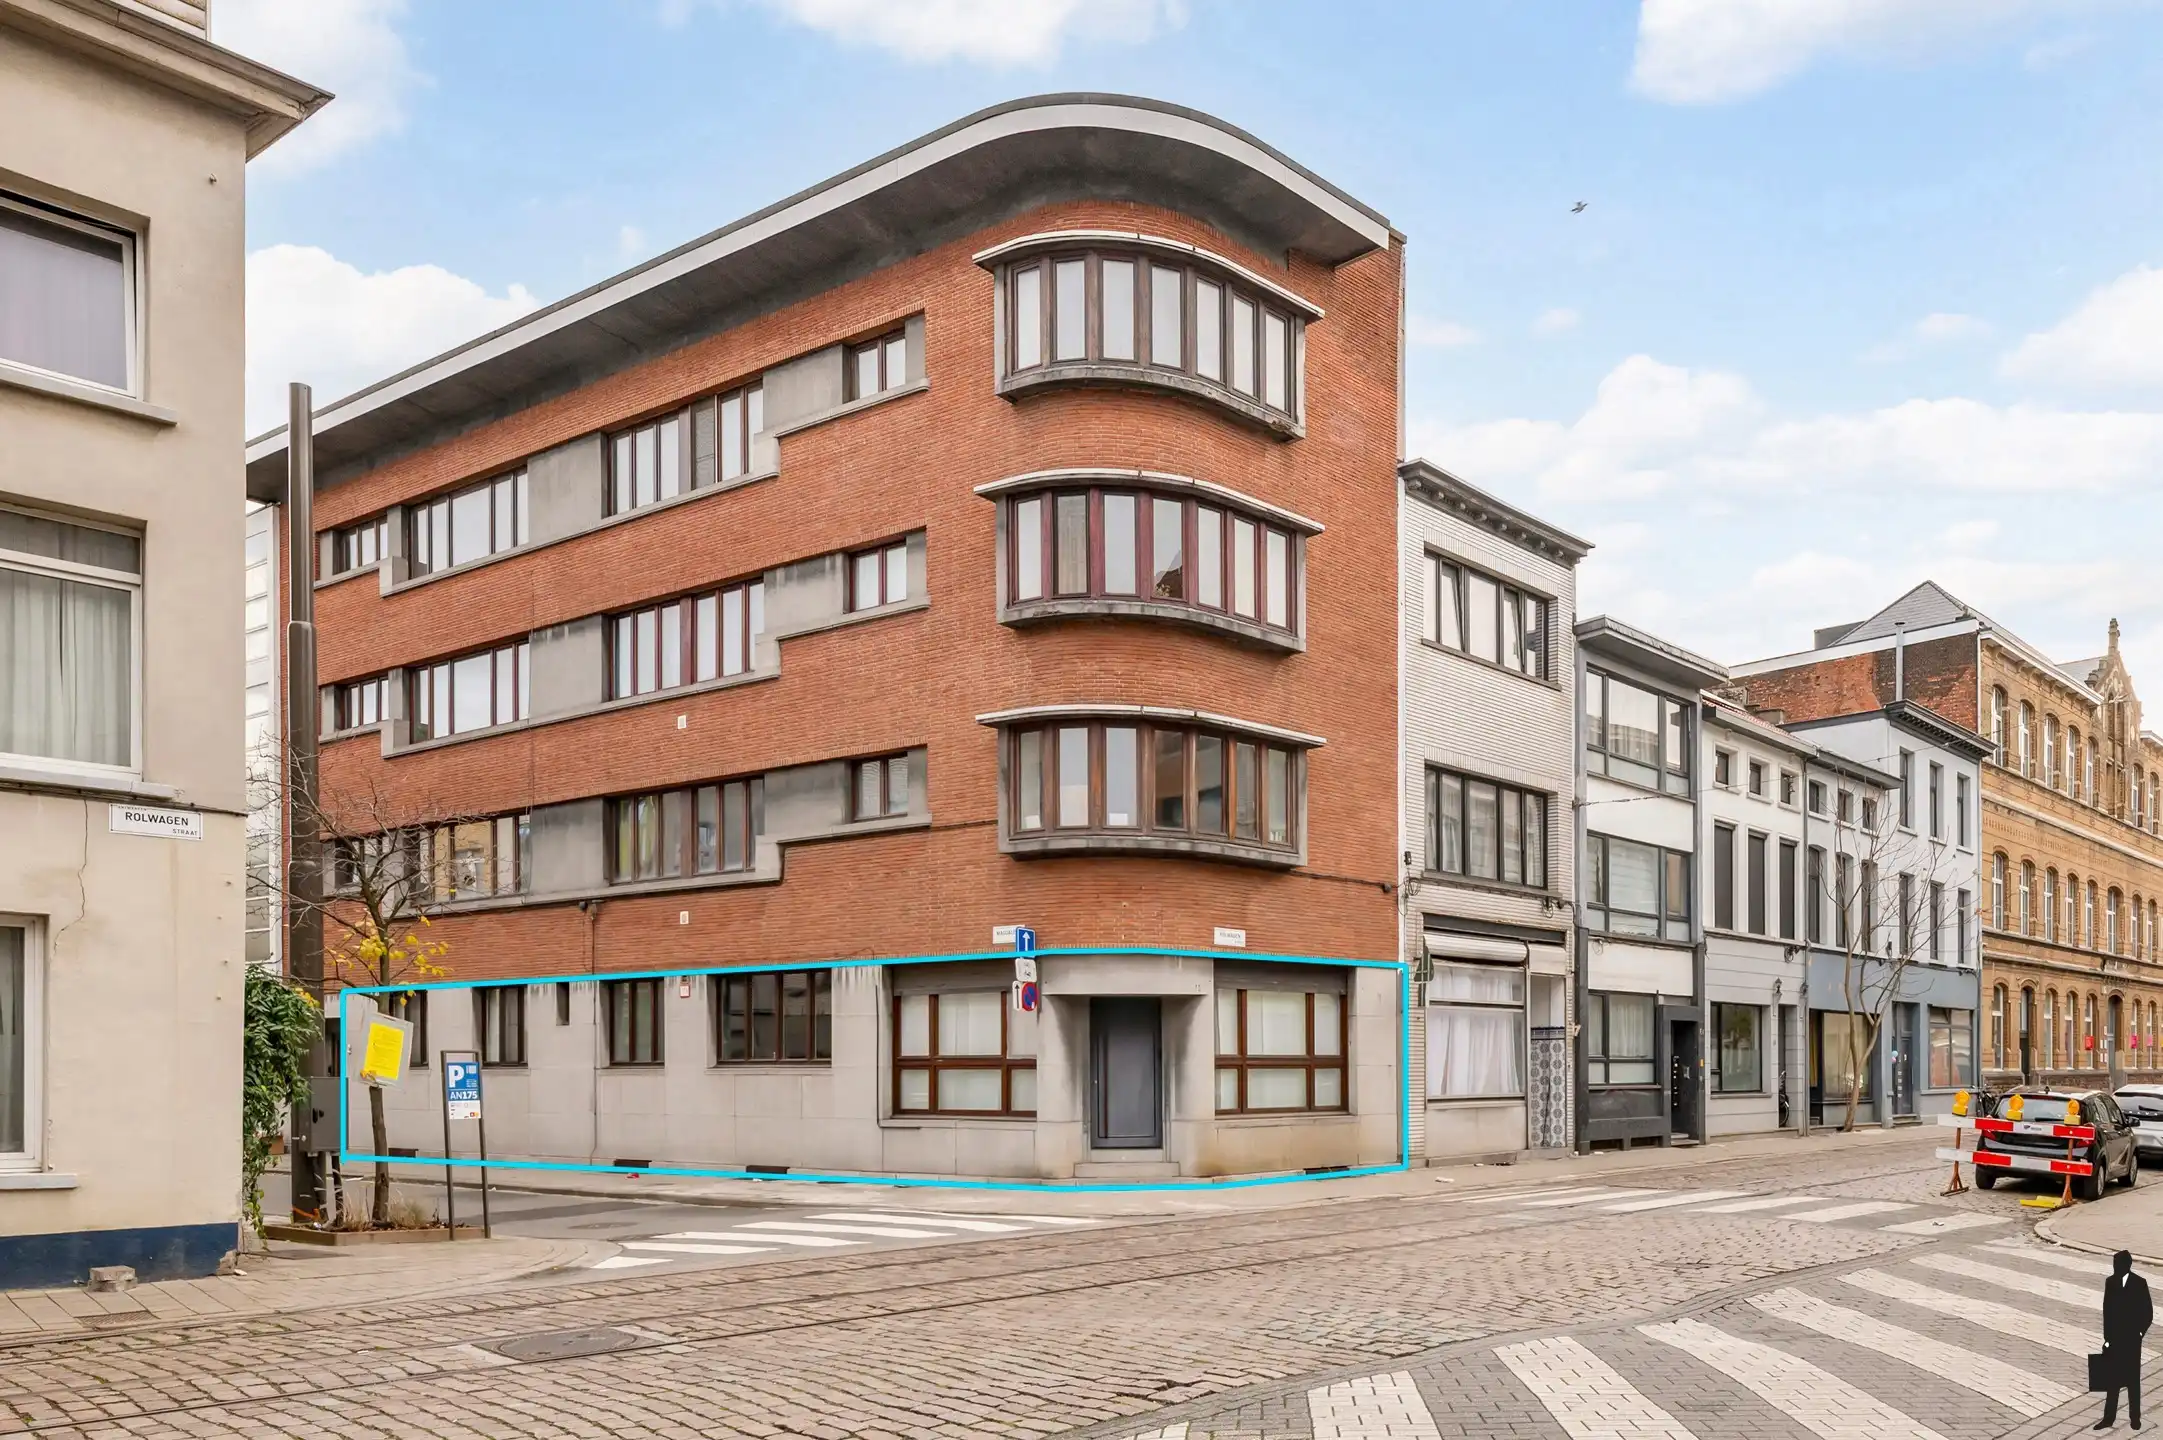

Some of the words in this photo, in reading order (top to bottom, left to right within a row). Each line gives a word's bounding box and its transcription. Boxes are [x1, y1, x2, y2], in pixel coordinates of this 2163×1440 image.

[125, 811, 189, 826] ROLWAGEN
[172, 828, 198, 836] STRAAT
[448, 1065, 465, 1088] P
[450, 1091, 478, 1100] AN175
